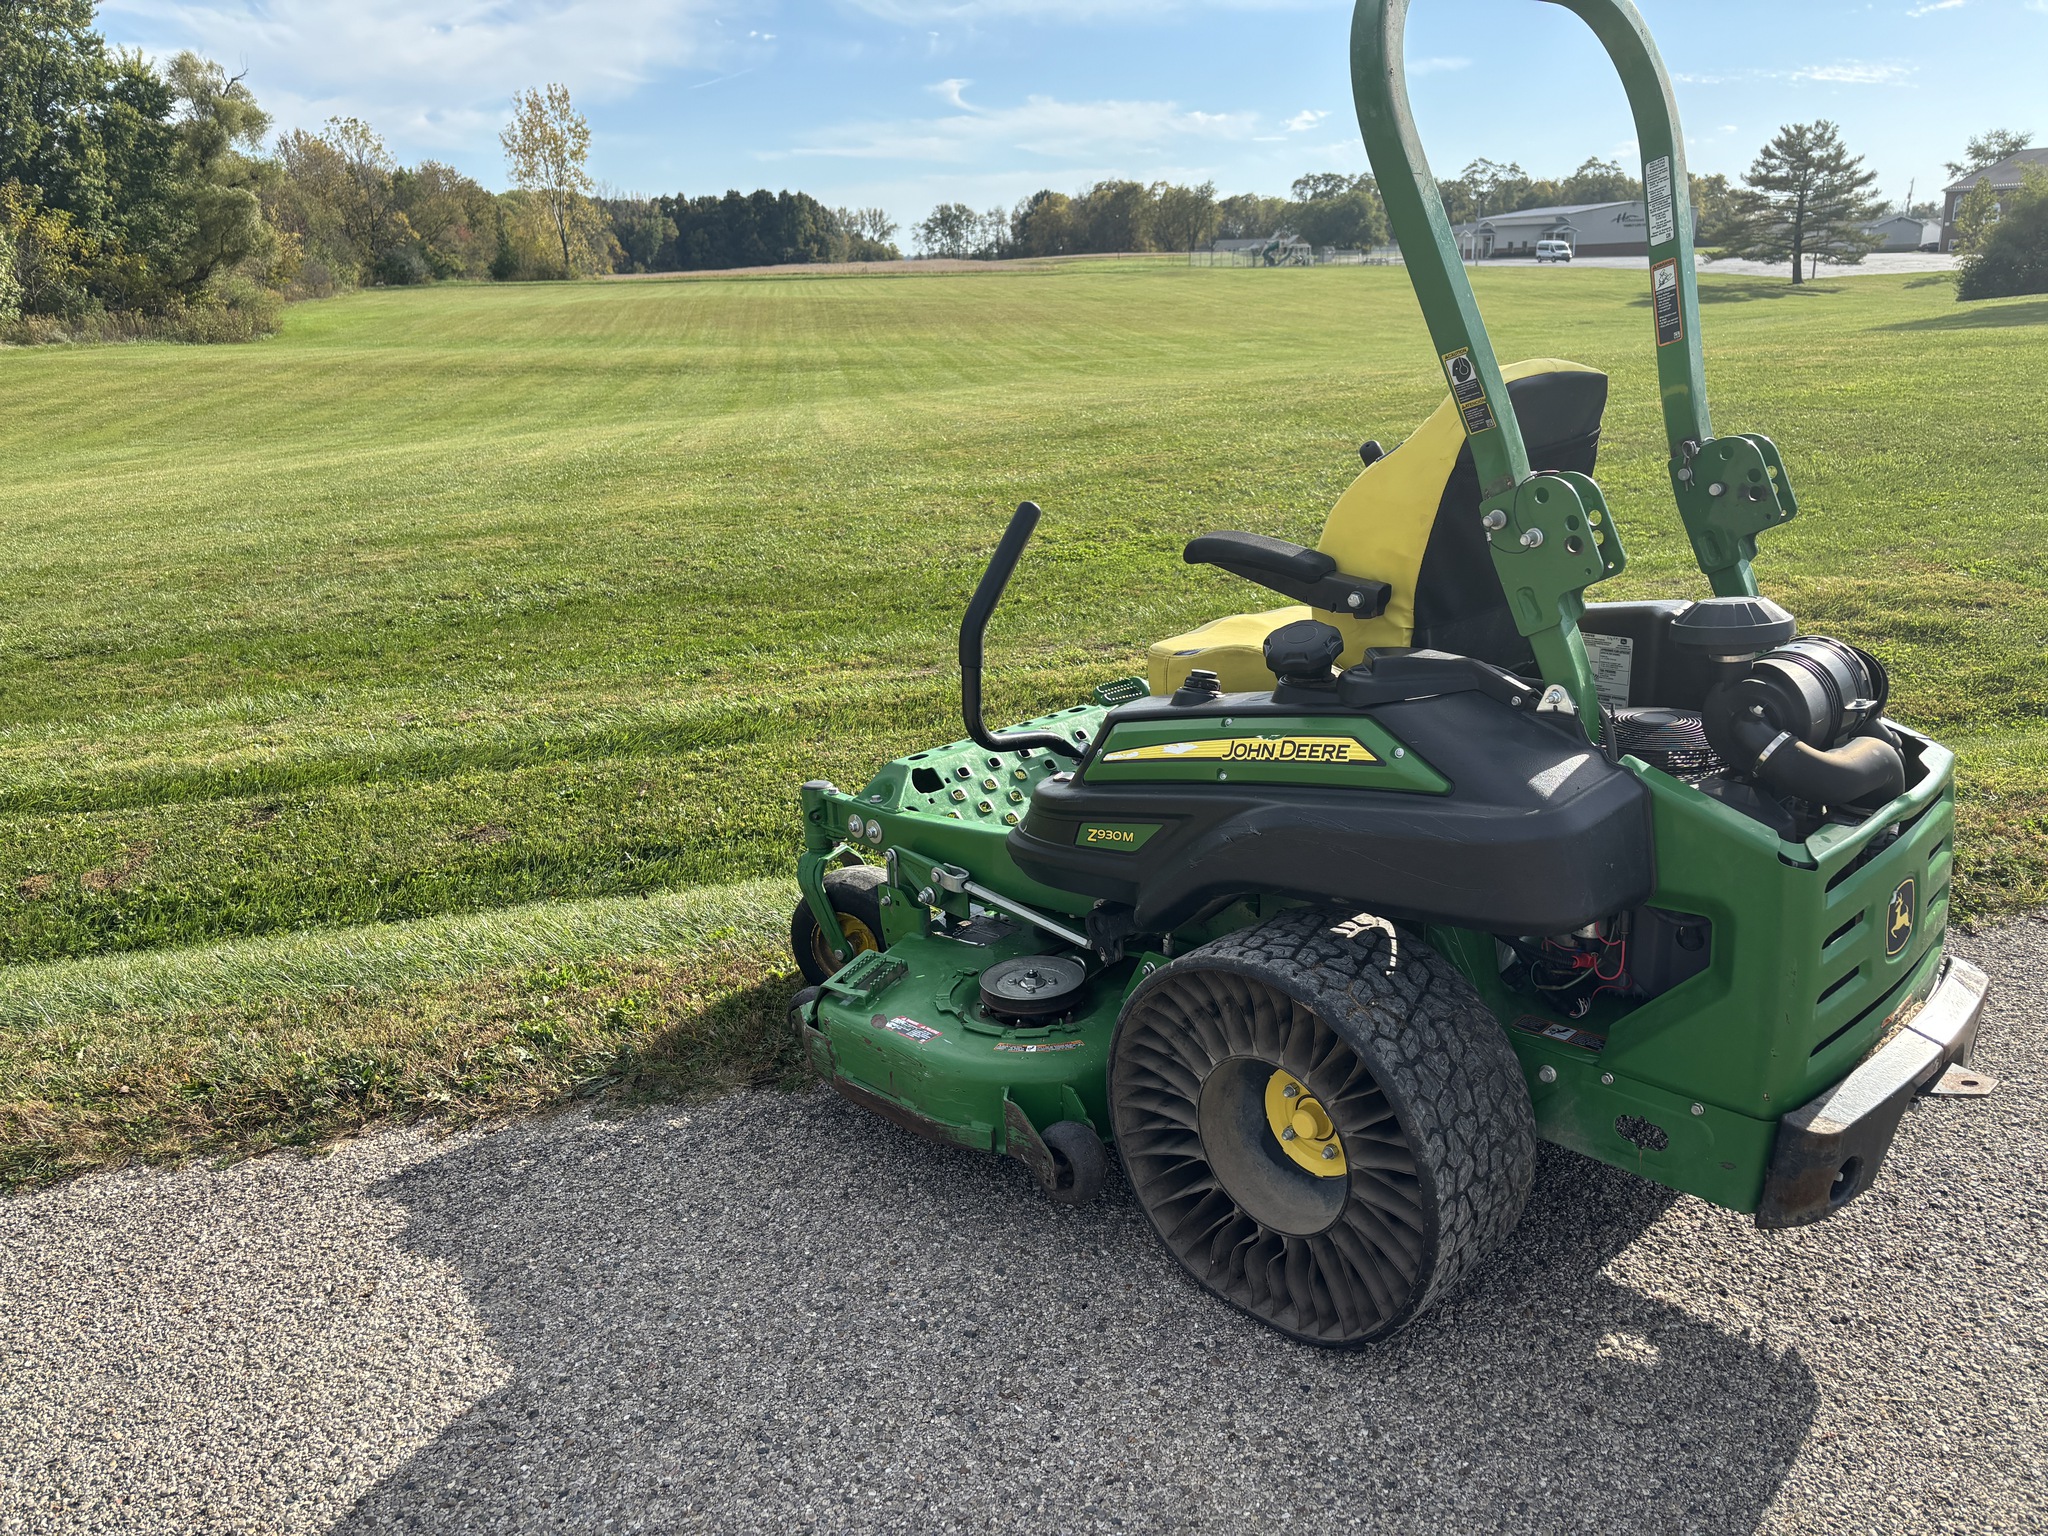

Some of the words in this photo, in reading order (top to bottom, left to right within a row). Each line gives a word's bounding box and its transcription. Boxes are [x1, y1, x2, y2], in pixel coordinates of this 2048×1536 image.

[1222, 740, 1276, 759] JOHN
[1279, 740, 1350, 760] DEERE
[1087, 828, 1134, 842] Z930M
